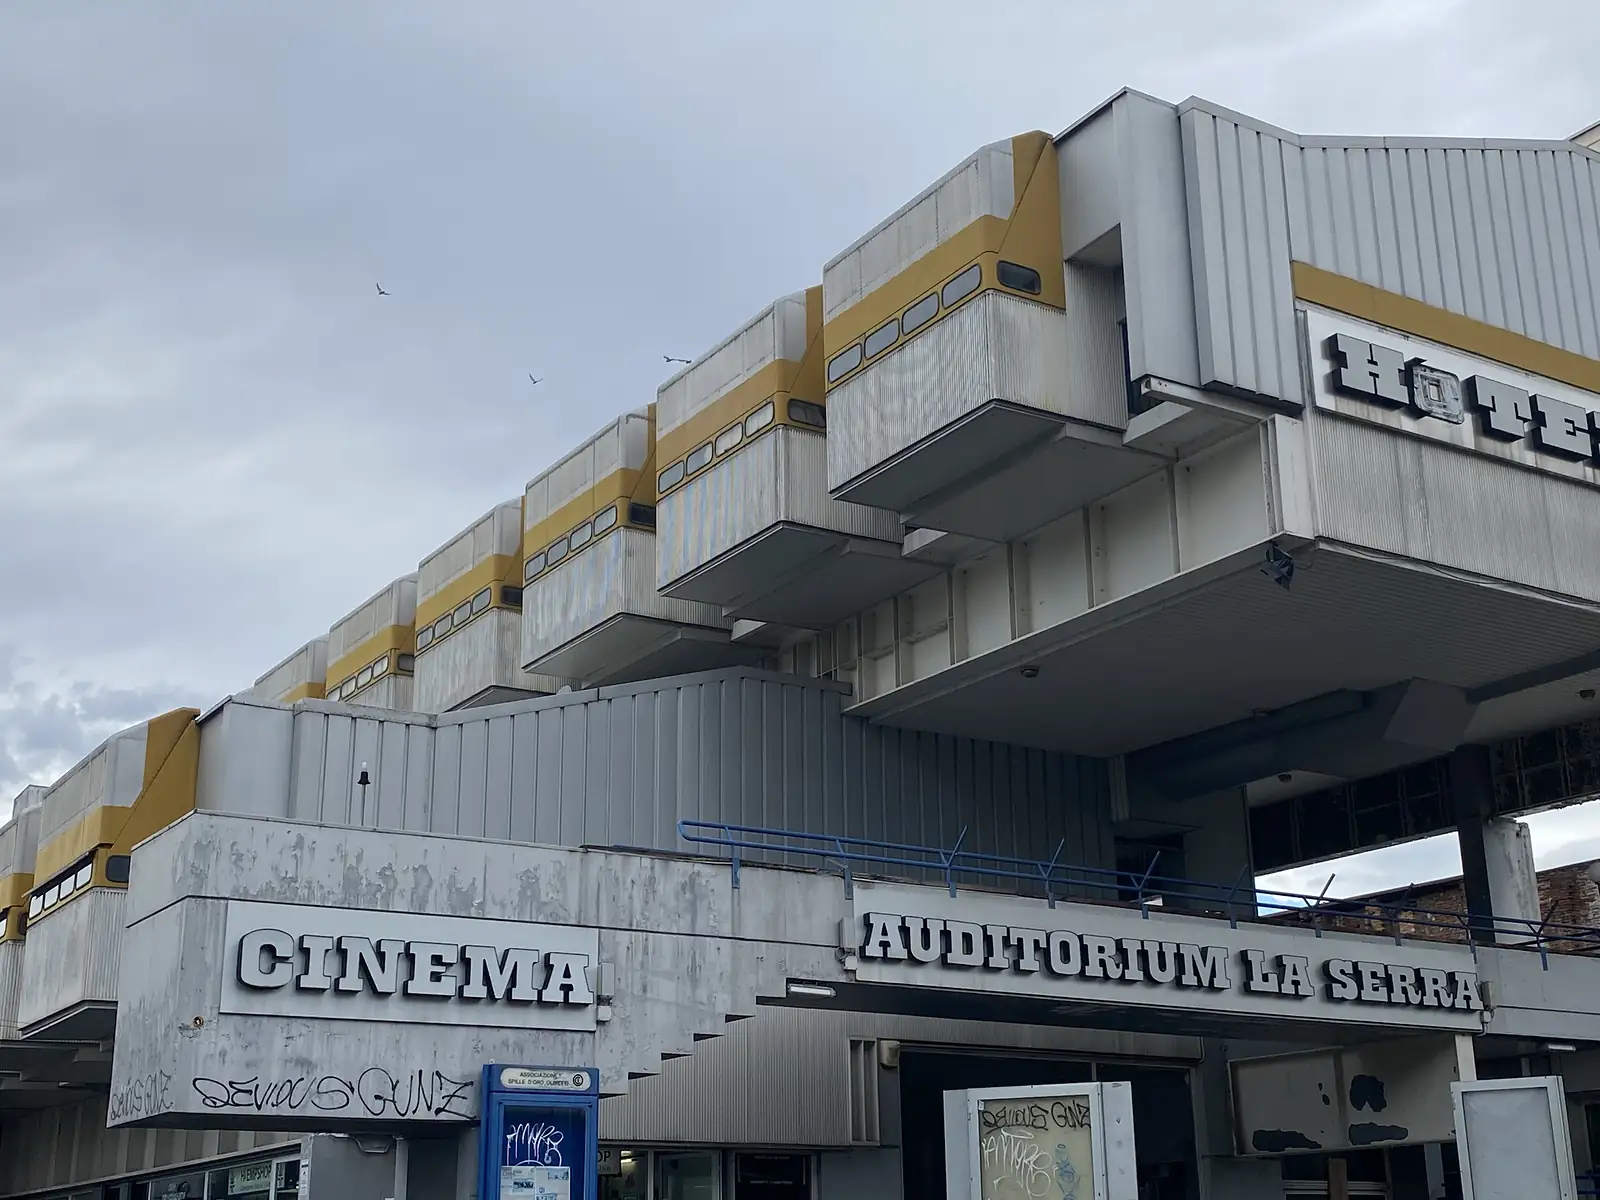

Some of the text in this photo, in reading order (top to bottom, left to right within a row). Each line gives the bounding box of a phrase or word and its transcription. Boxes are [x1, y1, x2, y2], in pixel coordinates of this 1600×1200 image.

[236, 927, 594, 1005] CINEMA
[859, 911, 1486, 1011] AUDITORIUM LA SERRA
